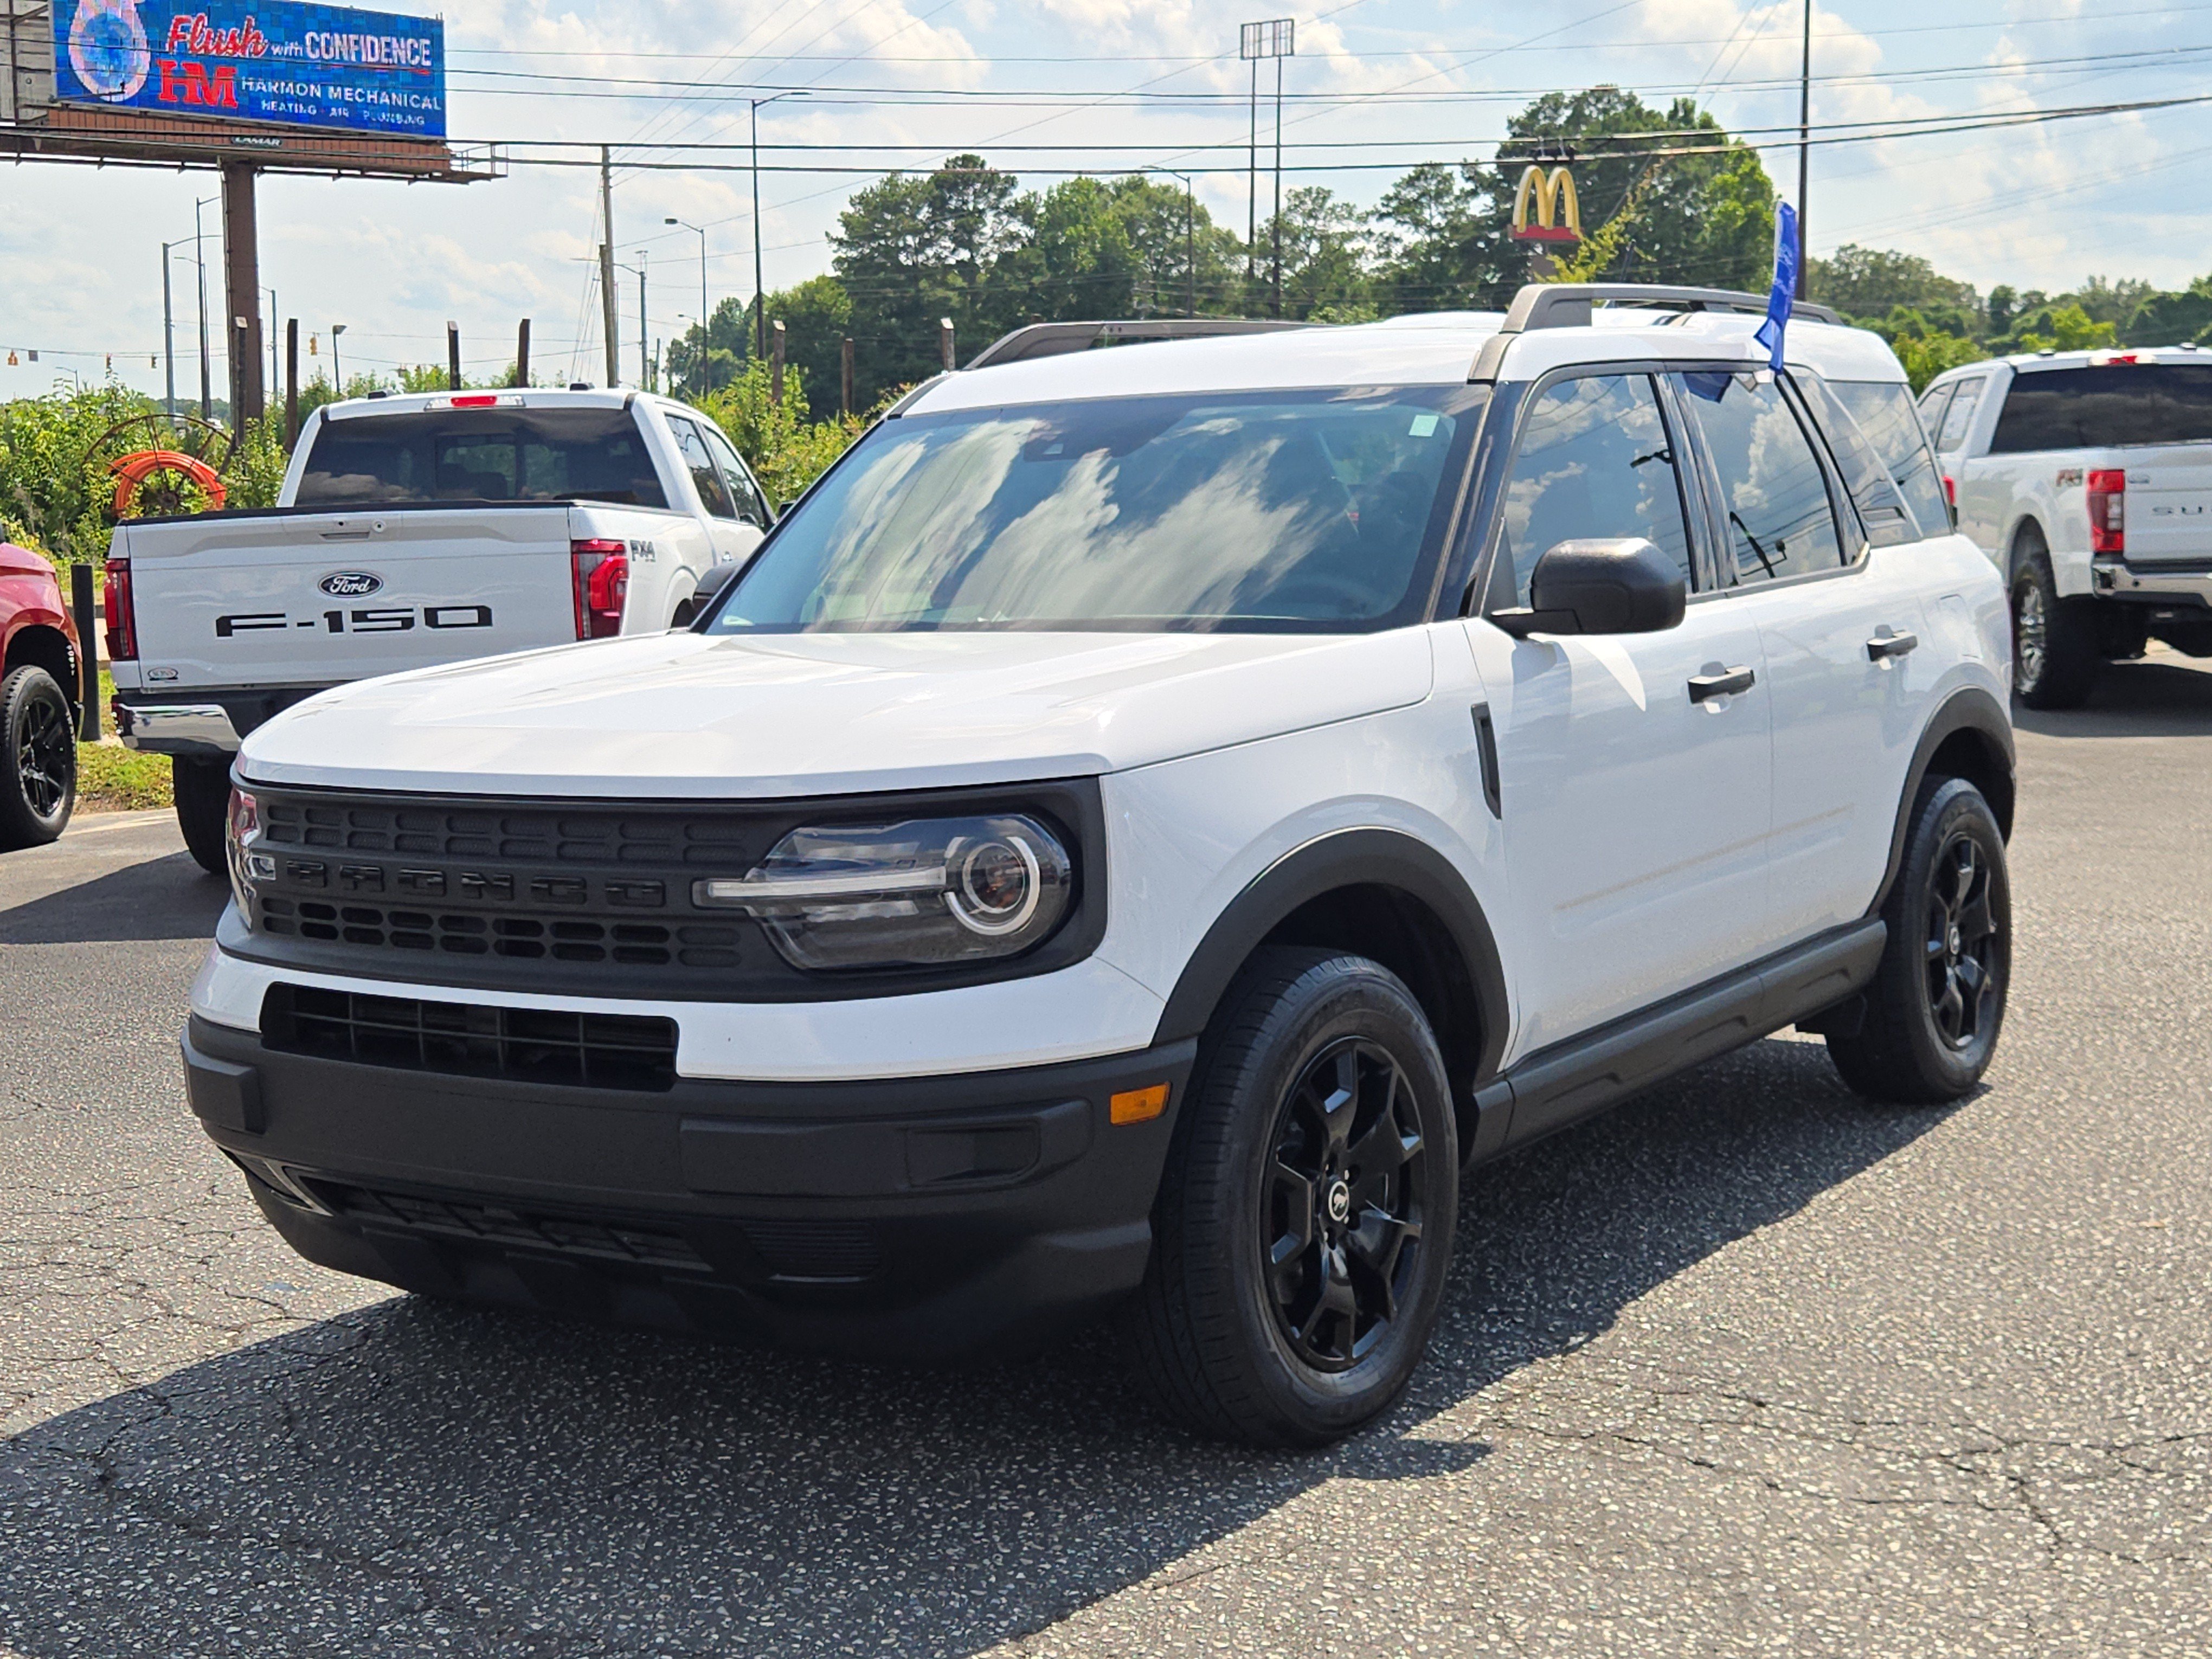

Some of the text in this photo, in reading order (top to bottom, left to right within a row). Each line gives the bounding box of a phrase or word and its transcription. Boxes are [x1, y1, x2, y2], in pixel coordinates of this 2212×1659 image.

[166, 12, 432, 66] Flush with CONFIDENCE
[157, 57, 237, 107] HM
[241, 76, 442, 111] HARMON MECHANICAL
[235, 137, 281, 146] LAMAR
[2152, 506, 2212, 516] SU
[329, 576, 371, 594] Ford
[216, 605, 493, 637] F-150
[286, 860, 666, 908] BRONCO
